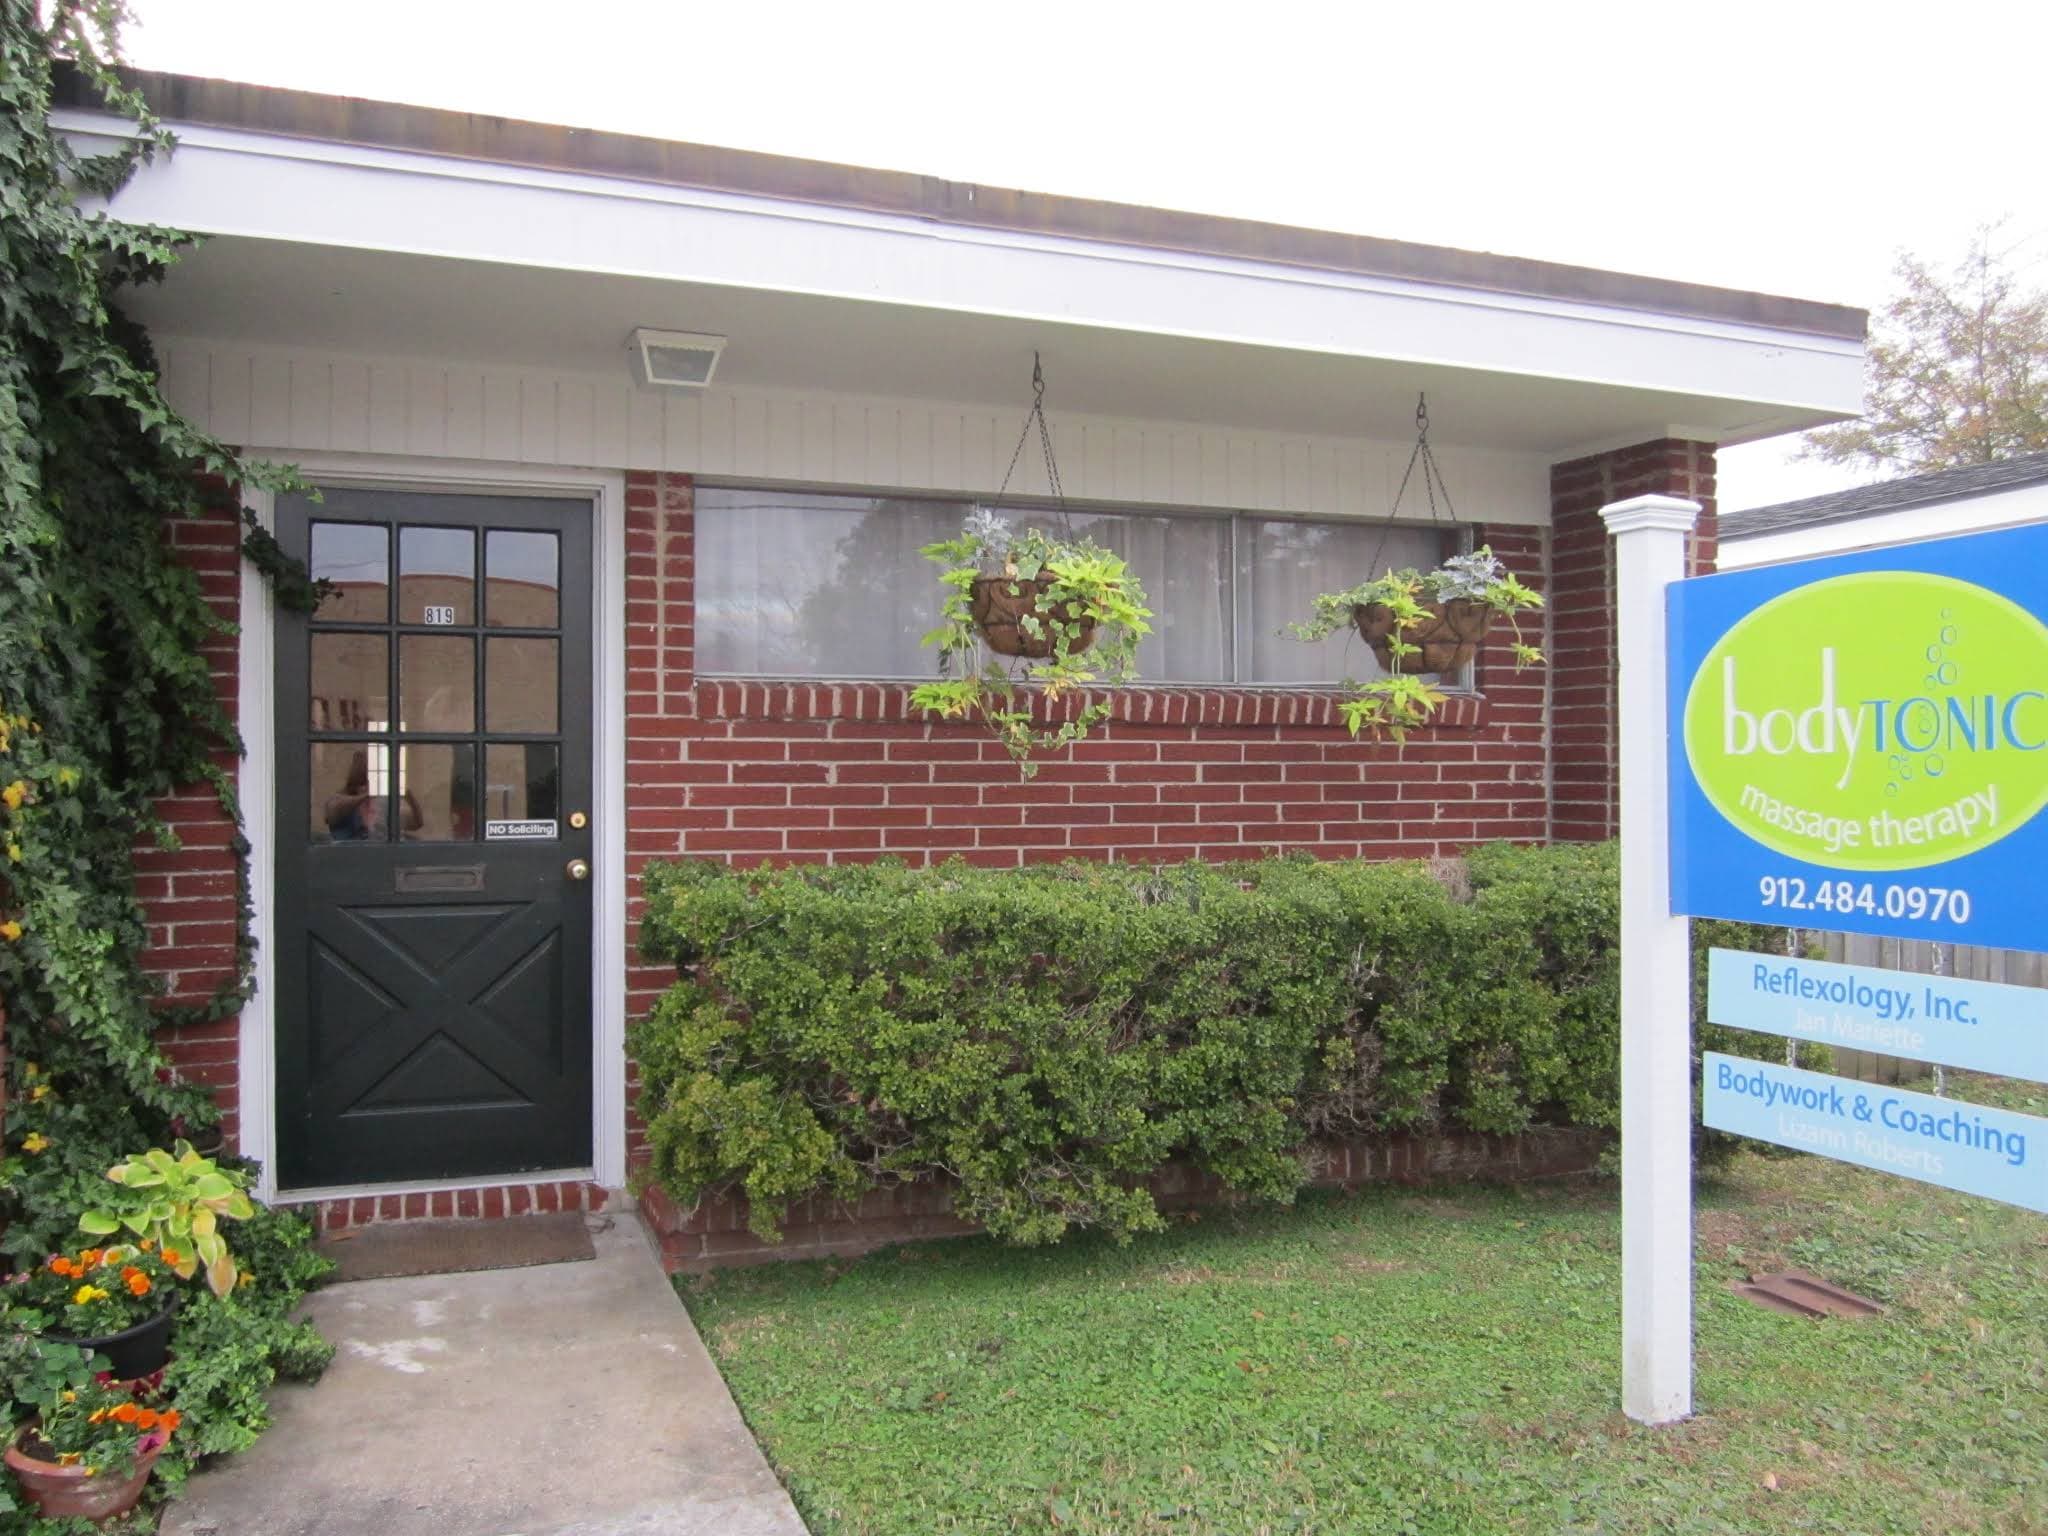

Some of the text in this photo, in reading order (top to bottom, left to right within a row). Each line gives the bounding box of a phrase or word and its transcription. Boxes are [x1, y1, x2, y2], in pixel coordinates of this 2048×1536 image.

[426, 607, 453, 624] 819
[489, 823, 553, 836] NO Soliciting
[1740, 783, 1998, 853] massage therapy
[1759, 876, 1971, 924] 912.484.0970
[1753, 963, 1978, 1025] Reflexology, Inc.
[1717, 1063, 2026, 1167] Bodywork & Coaching
[1854, 1129, 1945, 1176] Roberts
